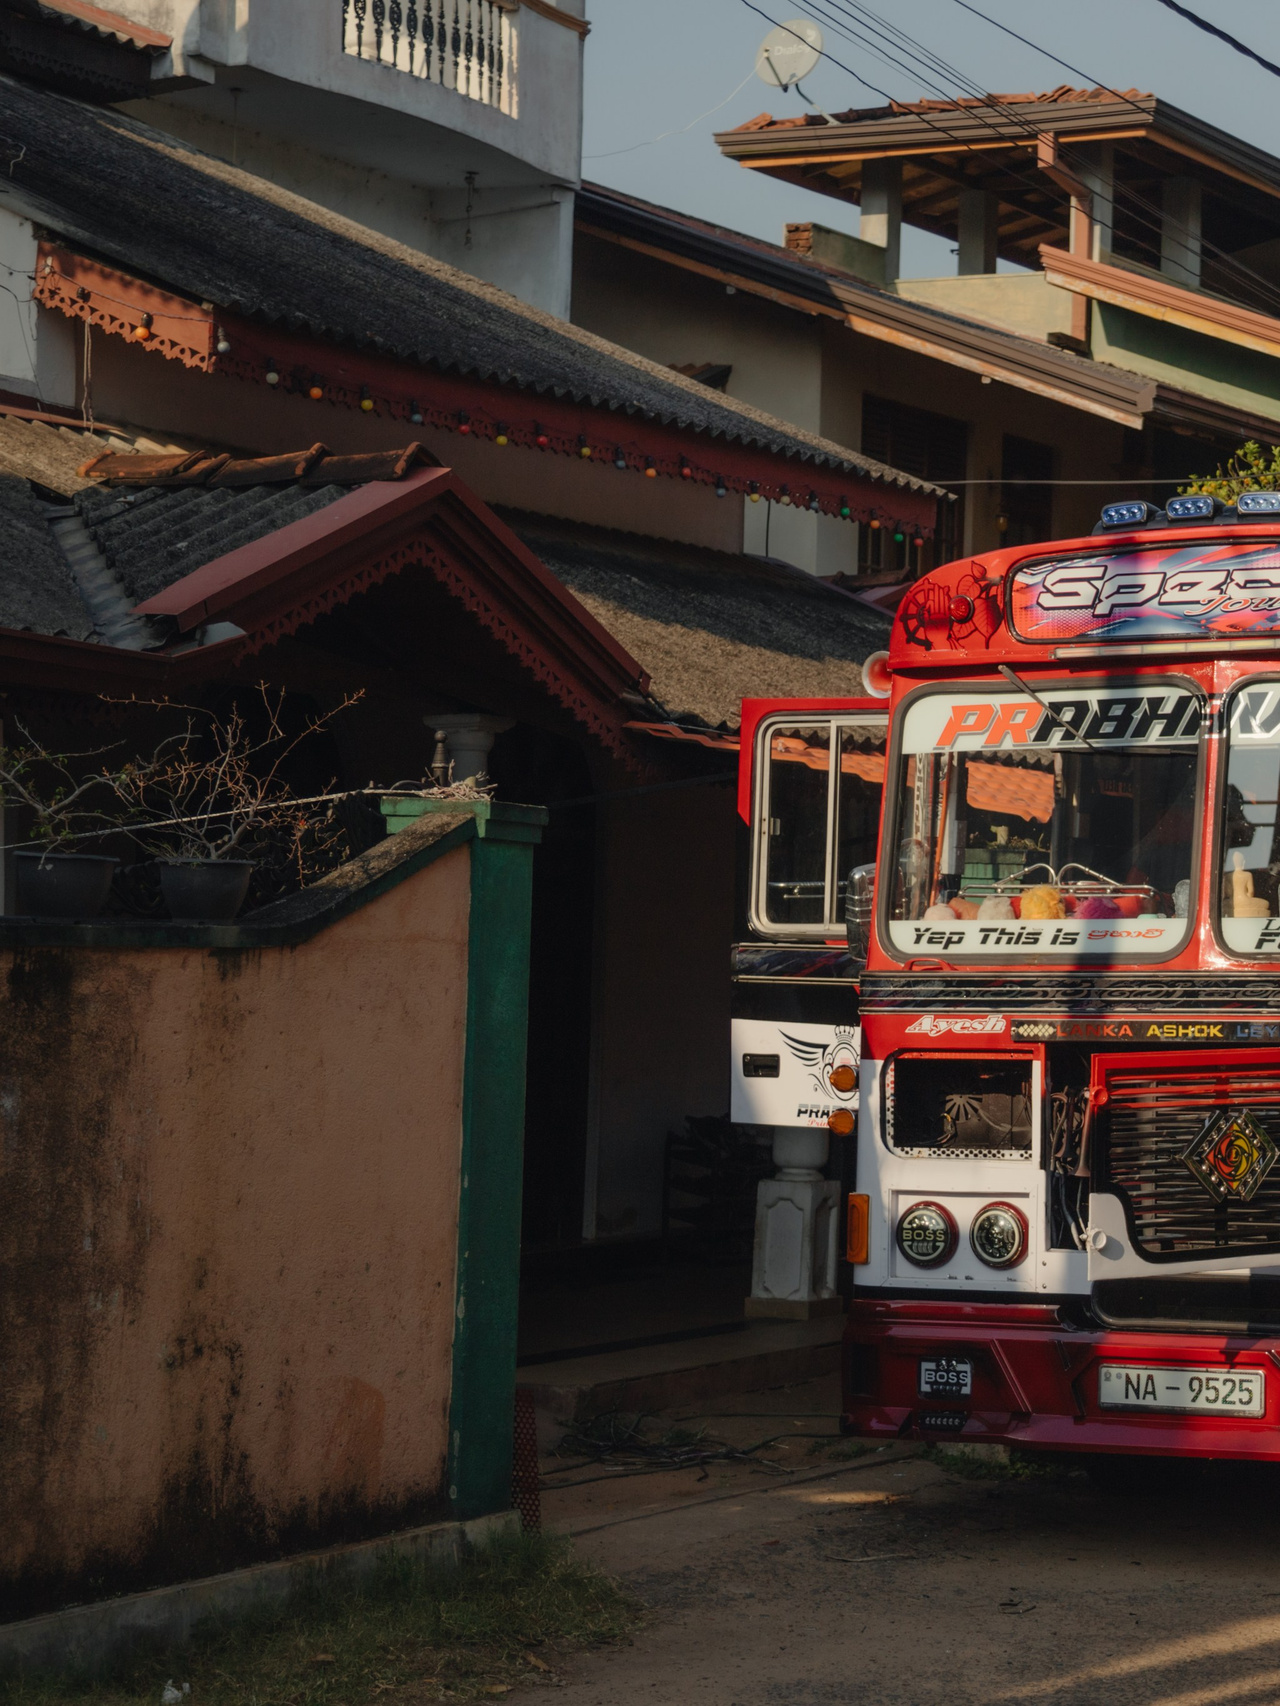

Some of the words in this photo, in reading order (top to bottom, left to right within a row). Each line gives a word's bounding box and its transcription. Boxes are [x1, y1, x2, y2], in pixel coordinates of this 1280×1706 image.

[913, 927, 966, 950] Yep
[978, 926, 1043, 945] This
[1050, 928, 1080, 945] is
[904, 1014, 1007, 1037] Ayesh
[1057, 1023, 1133, 1038] LANKA
[1146, 1023, 1224, 1038] ASHOK
[902, 1229, 945, 1241] BOSS
[925, 1371, 968, 1384] BOSS
[1124, 1373, 1157, 1401] NA
[1188, 1376, 1254, 1406] 9525
